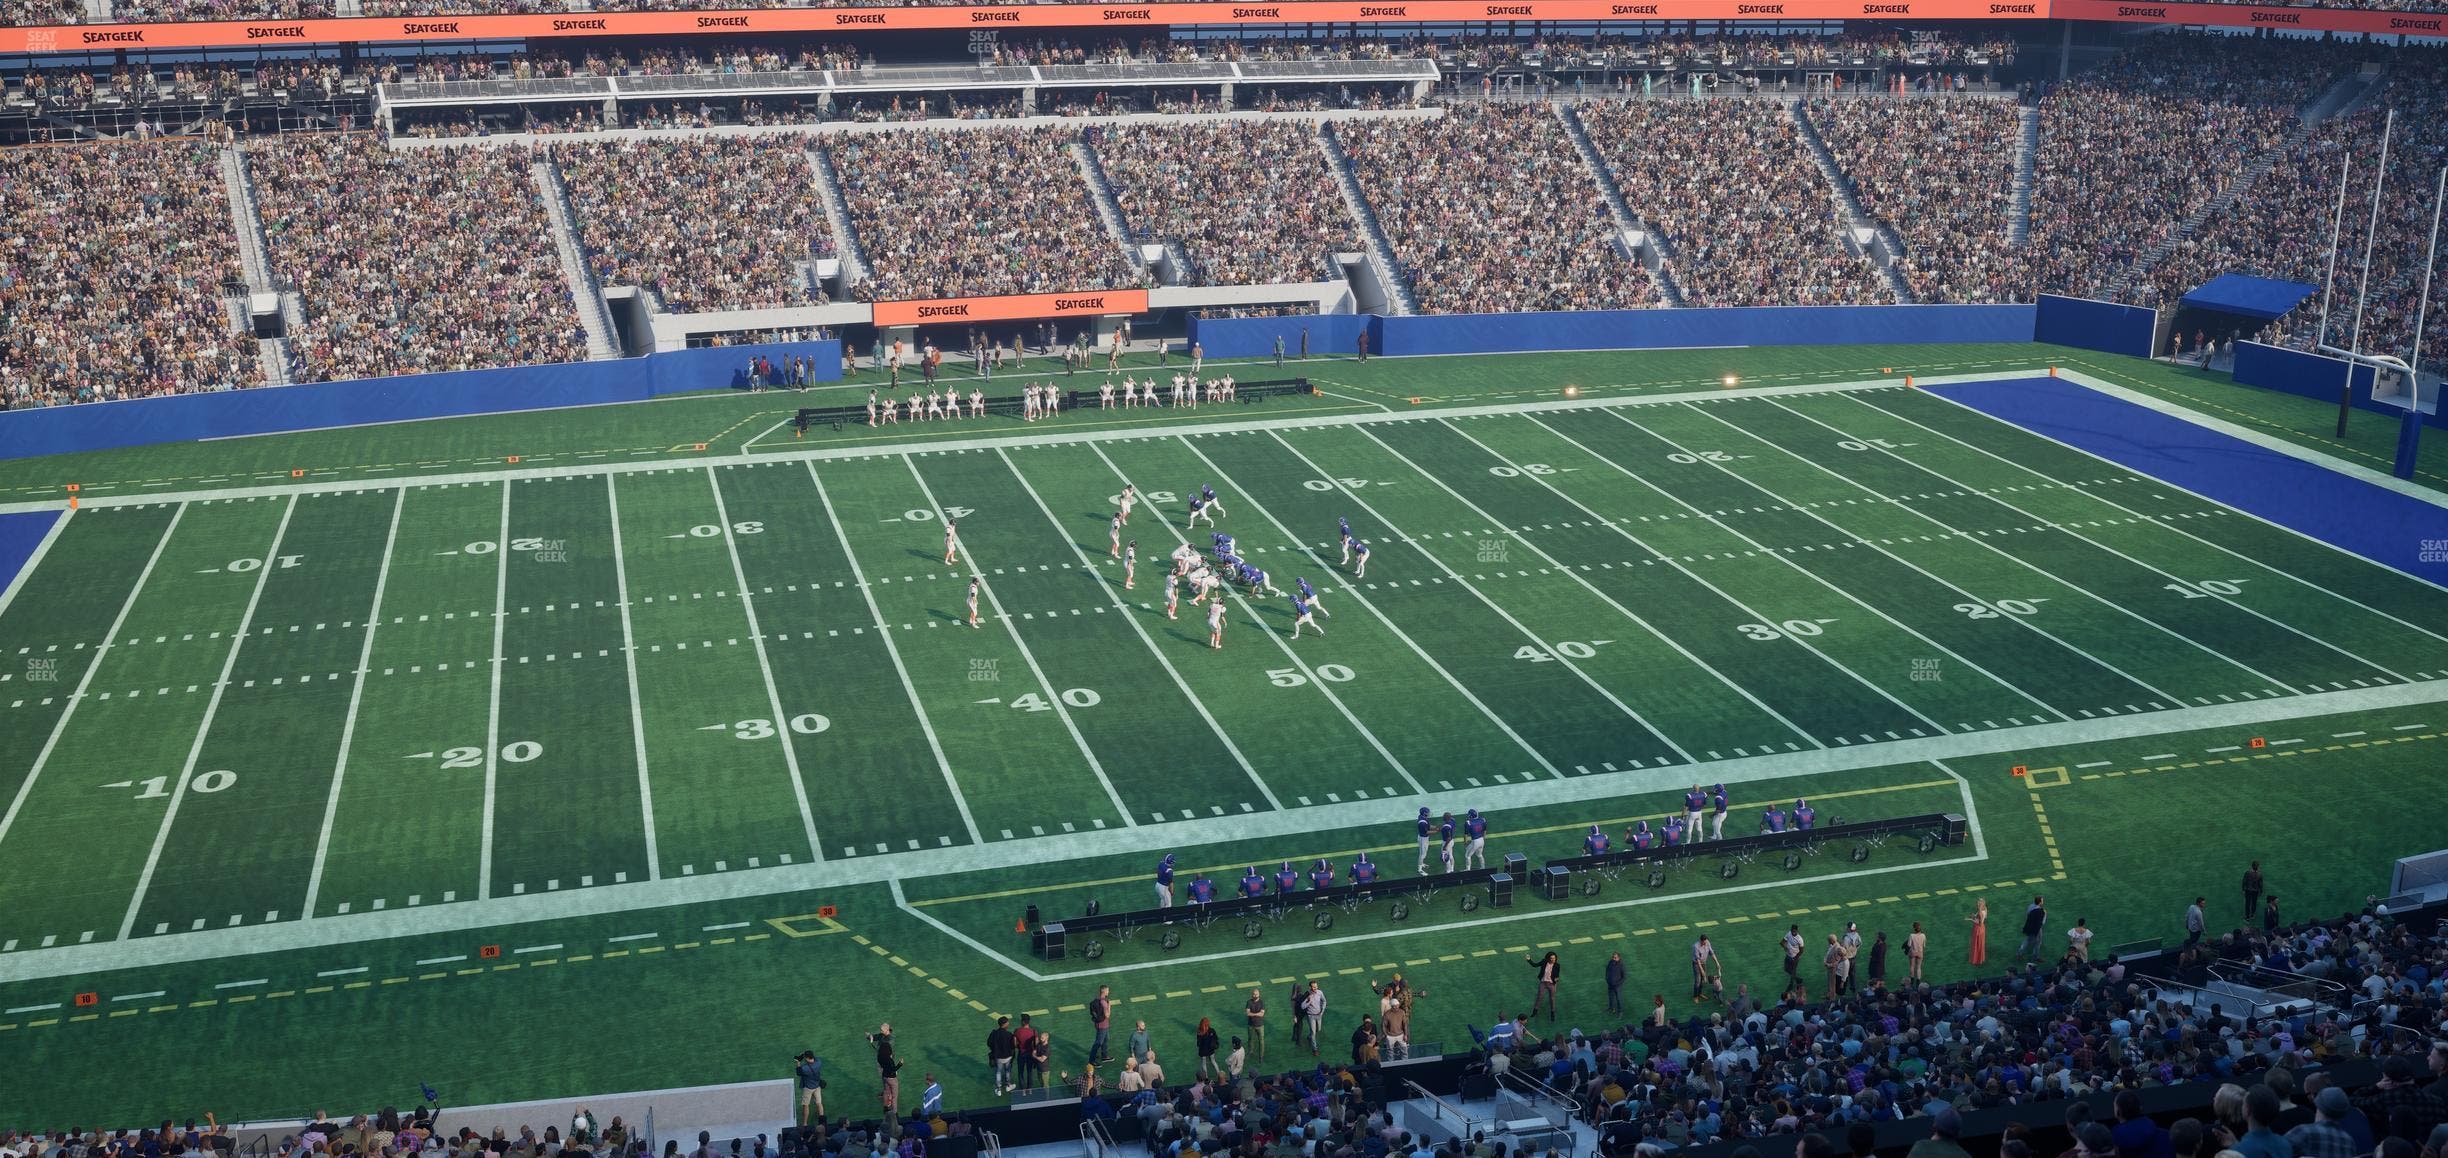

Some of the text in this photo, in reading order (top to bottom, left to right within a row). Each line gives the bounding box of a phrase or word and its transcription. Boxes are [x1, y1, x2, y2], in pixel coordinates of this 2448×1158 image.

[1233, 8, 1279, 18] SEATGEEK
[1361, 7, 1406, 16] SEATGEEK
[1487, 6, 1532, 15] SEATGEEK
[1612, 5, 1657, 14] SEATGEEK
[1738, 5, 1783, 14] SEATGEEK
[1864, 4, 1909, 13] SEATGEEK
[1990, 4, 2035, 13] SEATGEEK
[2118, 7, 2166, 18] SEATGEEK
[836, 14, 885, 24] SEATGEEK
[972, 12, 1019, 22] SEATGEEK
[1104, 10, 1150, 20] SEATGEEK
[2251, 12, 2300, 24] SEATGEEK
[553, 19, 606, 30] SEATGEEK
[698, 17, 748, 27] SEATGEEK
[2390, 18, 2441, 31] SEATGEEK
[247, 26, 305, 38] SEATGEEK
[404, 23, 459, 34] SEATGEEK
[83, 31, 144, 43] SEATGEEK
[1056, 298, 1104, 310] SEATGEEK
[918, 304, 968, 317] SEATGEEK
[1836, 438, 1898, 452] 10
[1666, 450, 1734, 464] 20
[1489, 463, 1557, 478] 30
[1303, 477, 1369, 492] 40
[904, 506, 976, 522] 40
[690, 520, 765, 538] 30
[464, 537, 544, 555] 20
[227, 554, 305, 573] 10
[2163, 580, 2243, 600] 10
[1953, 599, 2040, 620] 20
[1736, 620, 1824, 641] 30
[1513, 641, 1597, 663] 40
[1265, 664, 1357, 687] 50
[1009, 688, 1102, 713] 40
[734, 713, 831, 740] 30
[440, 740, 544, 770] 20
[134, 770, 238, 800] 10
[485, 947, 495, 956] 20
[82, 995, 91, 1004] 10
